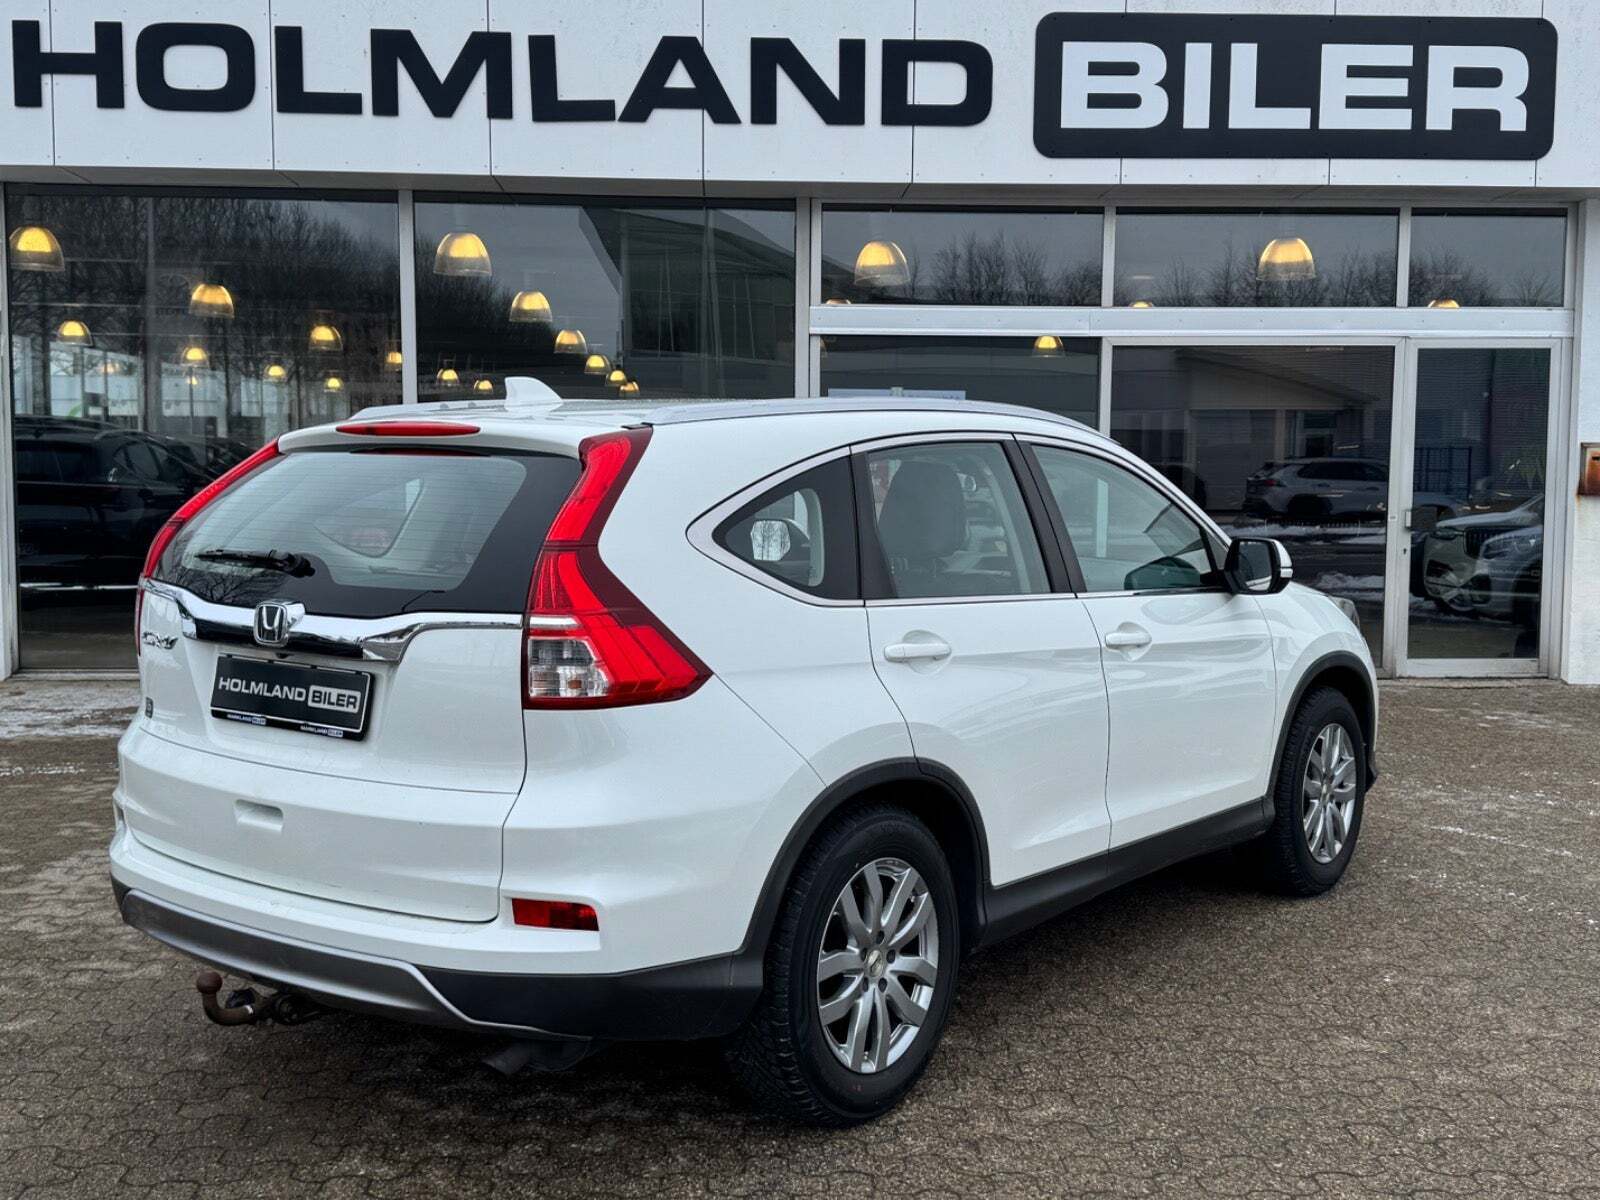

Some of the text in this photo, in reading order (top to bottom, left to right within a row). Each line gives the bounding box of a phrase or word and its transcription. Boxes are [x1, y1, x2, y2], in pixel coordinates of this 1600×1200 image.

[12, 20, 1530, 132] HOLMLAND BILER
[218, 676, 358, 710] HOLMLAND BILER
